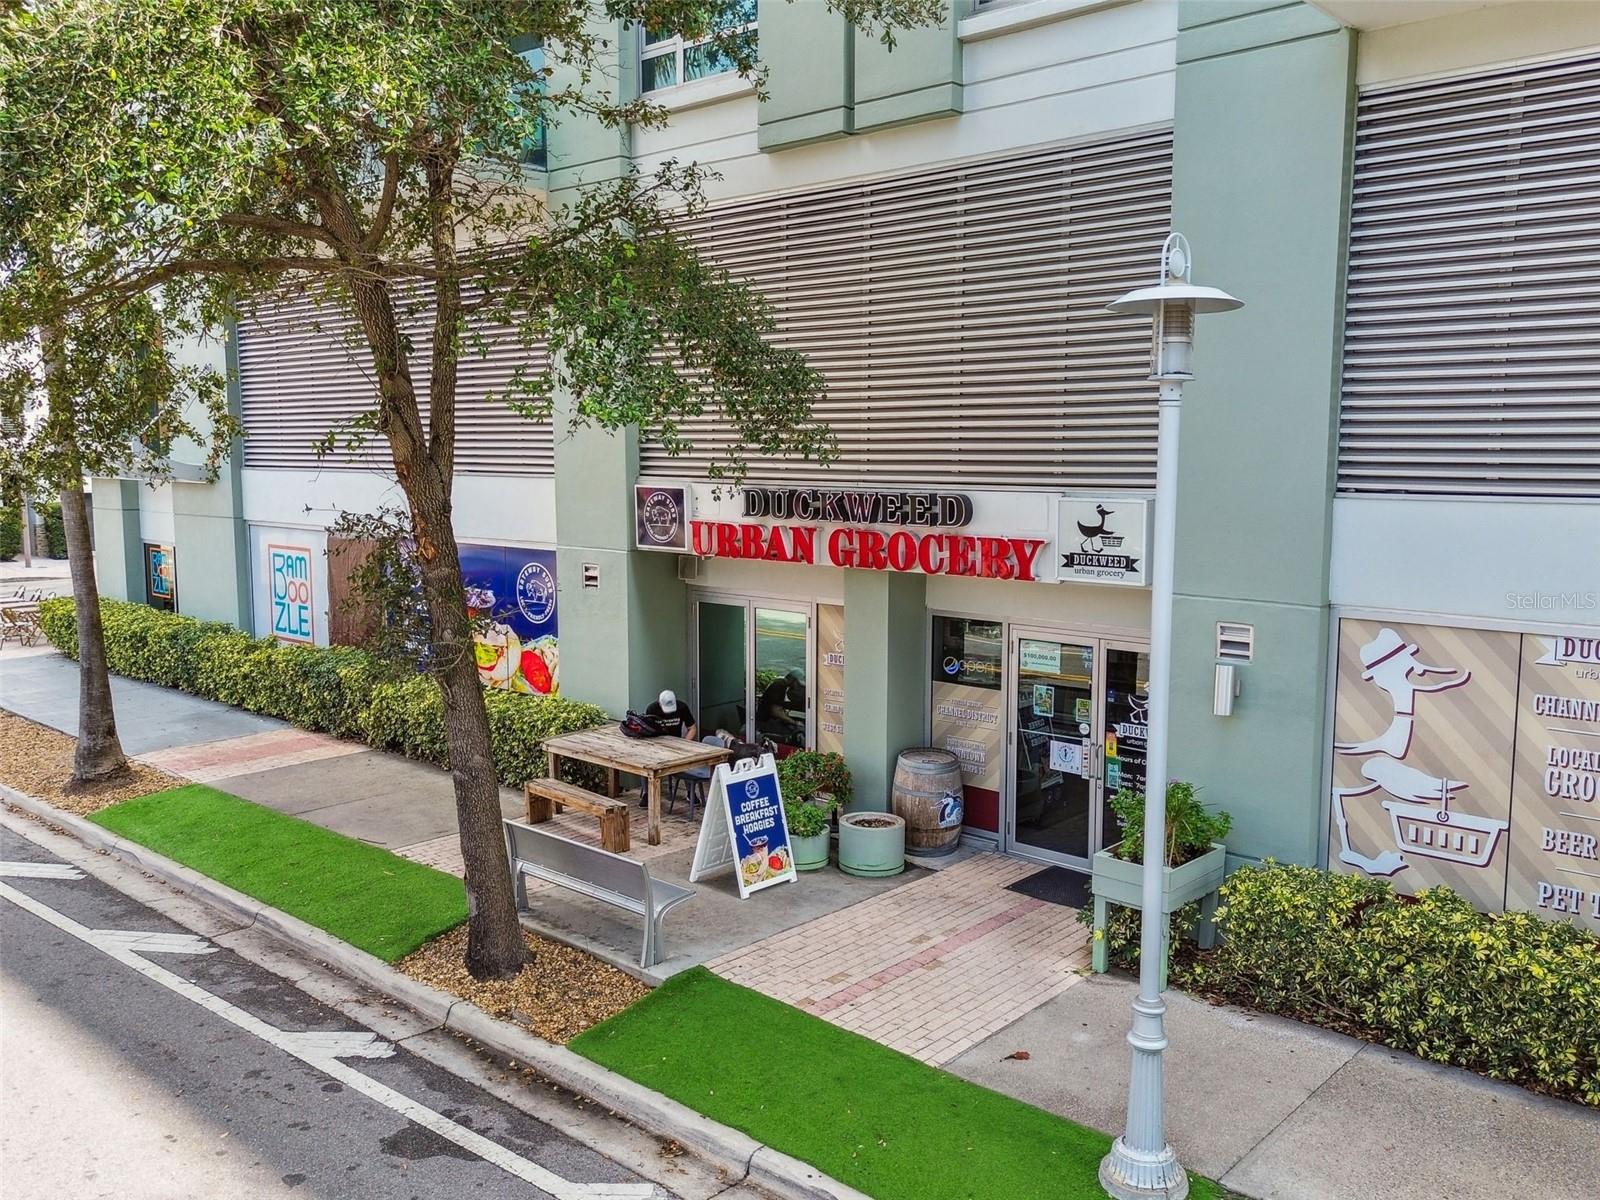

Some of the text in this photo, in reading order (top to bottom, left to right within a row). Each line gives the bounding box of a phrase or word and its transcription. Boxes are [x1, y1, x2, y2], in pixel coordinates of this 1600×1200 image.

[743, 488, 973, 529] DUCKWEED
[689, 520, 1046, 582] URBAN GROCERY
[1073, 554, 1127, 568] DUCKWEED
[1074, 567, 1126, 579] urban grocery
[1122, 725, 1148, 738] DUCK
[1544, 768, 1600, 802] CRO
[741, 797, 770, 812] COFFEE
[735, 805, 778, 826] BREAKFAST
[743, 818, 775, 834] HOAGIES
[1541, 827, 1599, 860] BEER
[1537, 881, 1584, 914] PET
